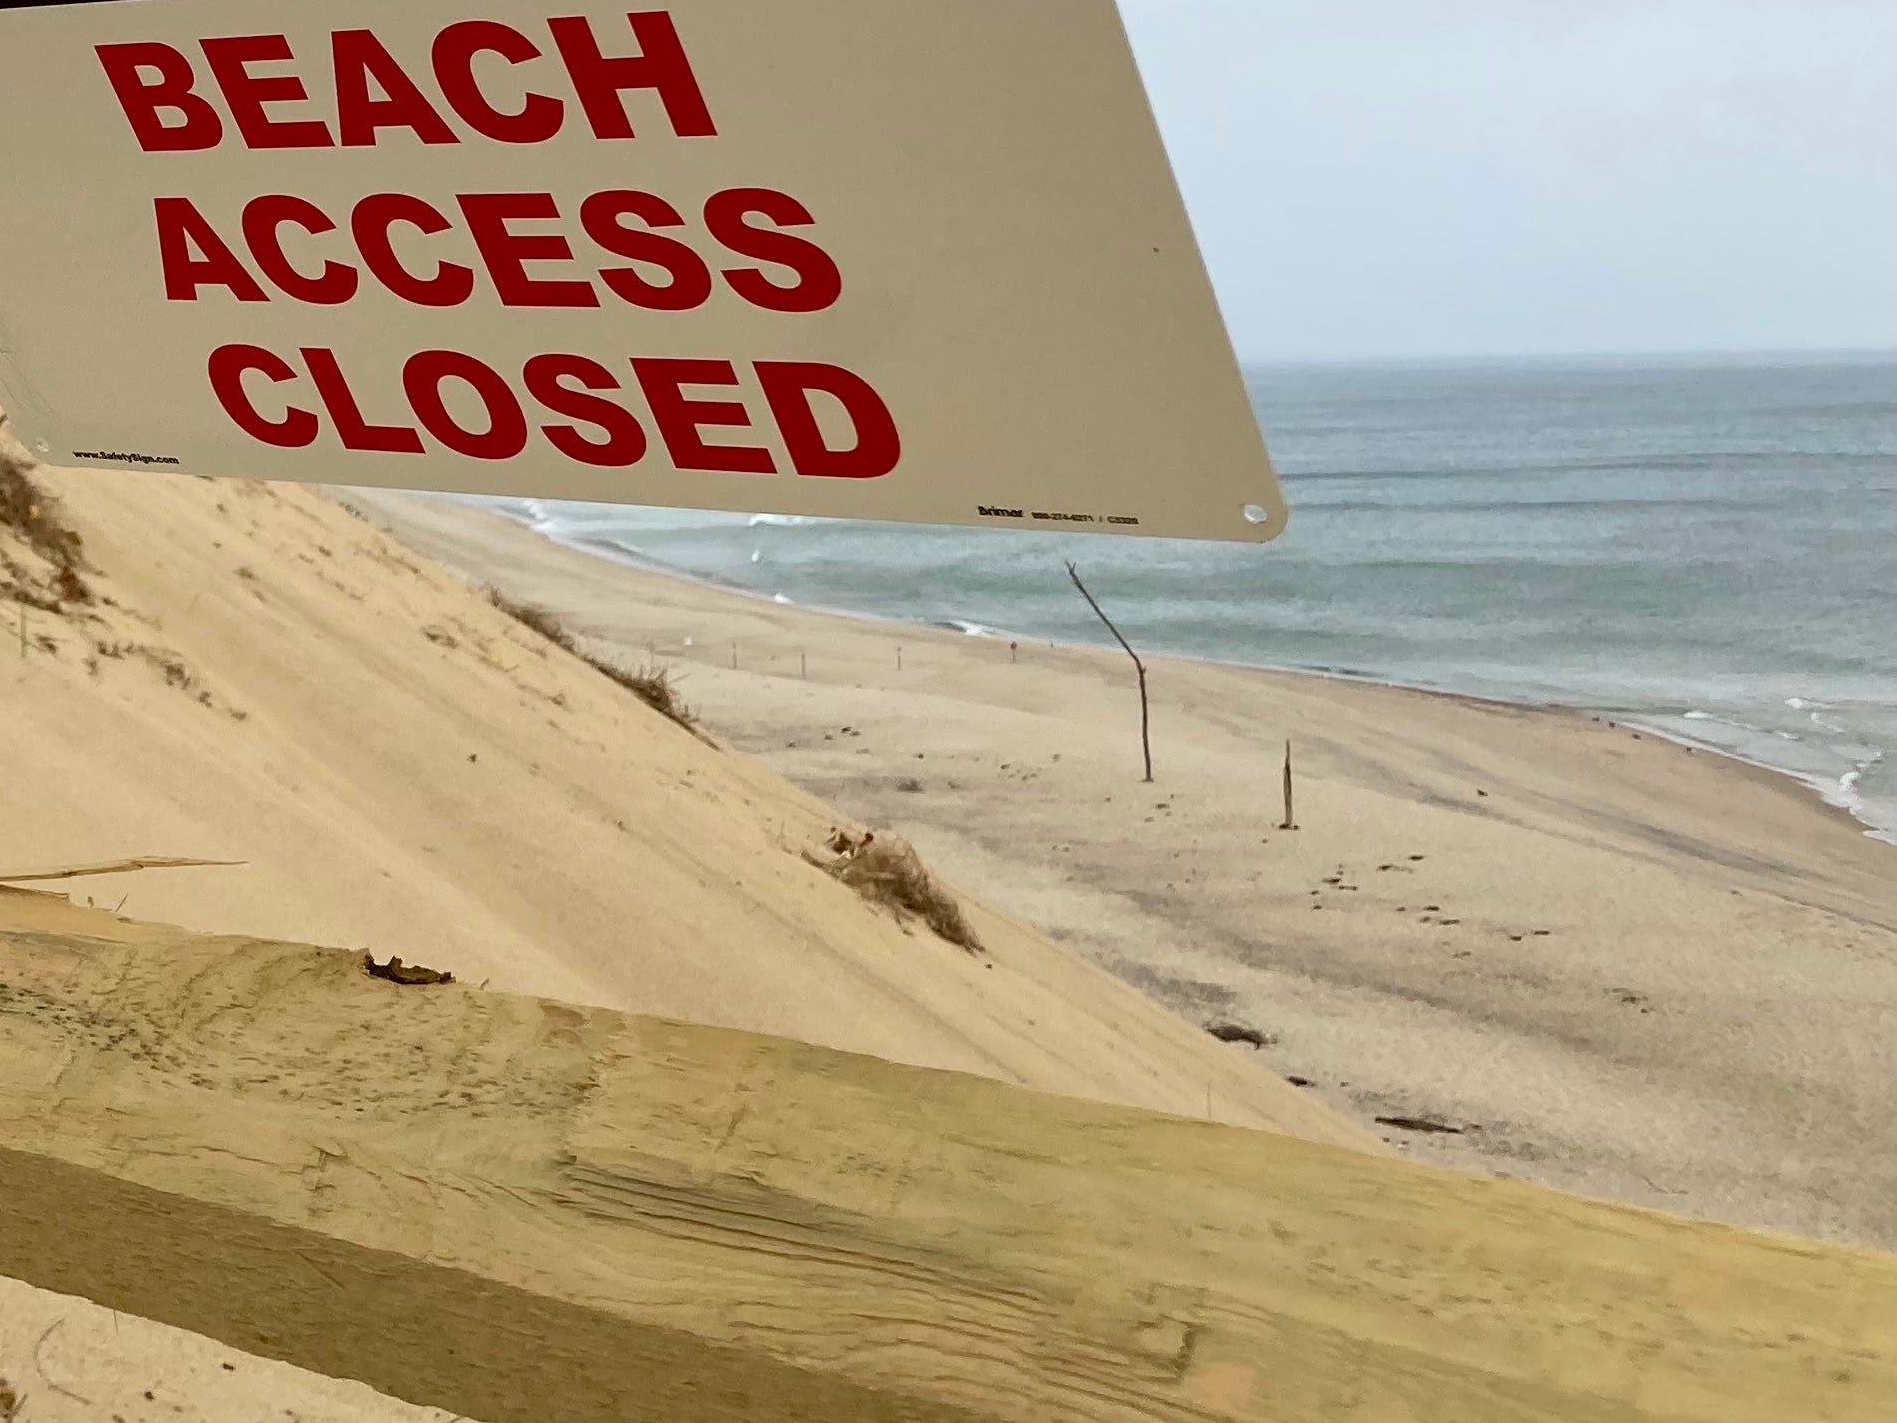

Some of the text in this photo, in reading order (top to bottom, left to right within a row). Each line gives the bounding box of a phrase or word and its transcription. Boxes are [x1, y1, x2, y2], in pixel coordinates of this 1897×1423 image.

[95, 11, 716, 152] BEACH
[154, 188, 842, 313] ACCESS
[72, 450, 180, 465] www.SafetySign.com
[207, 344, 901, 478] CLOSED
